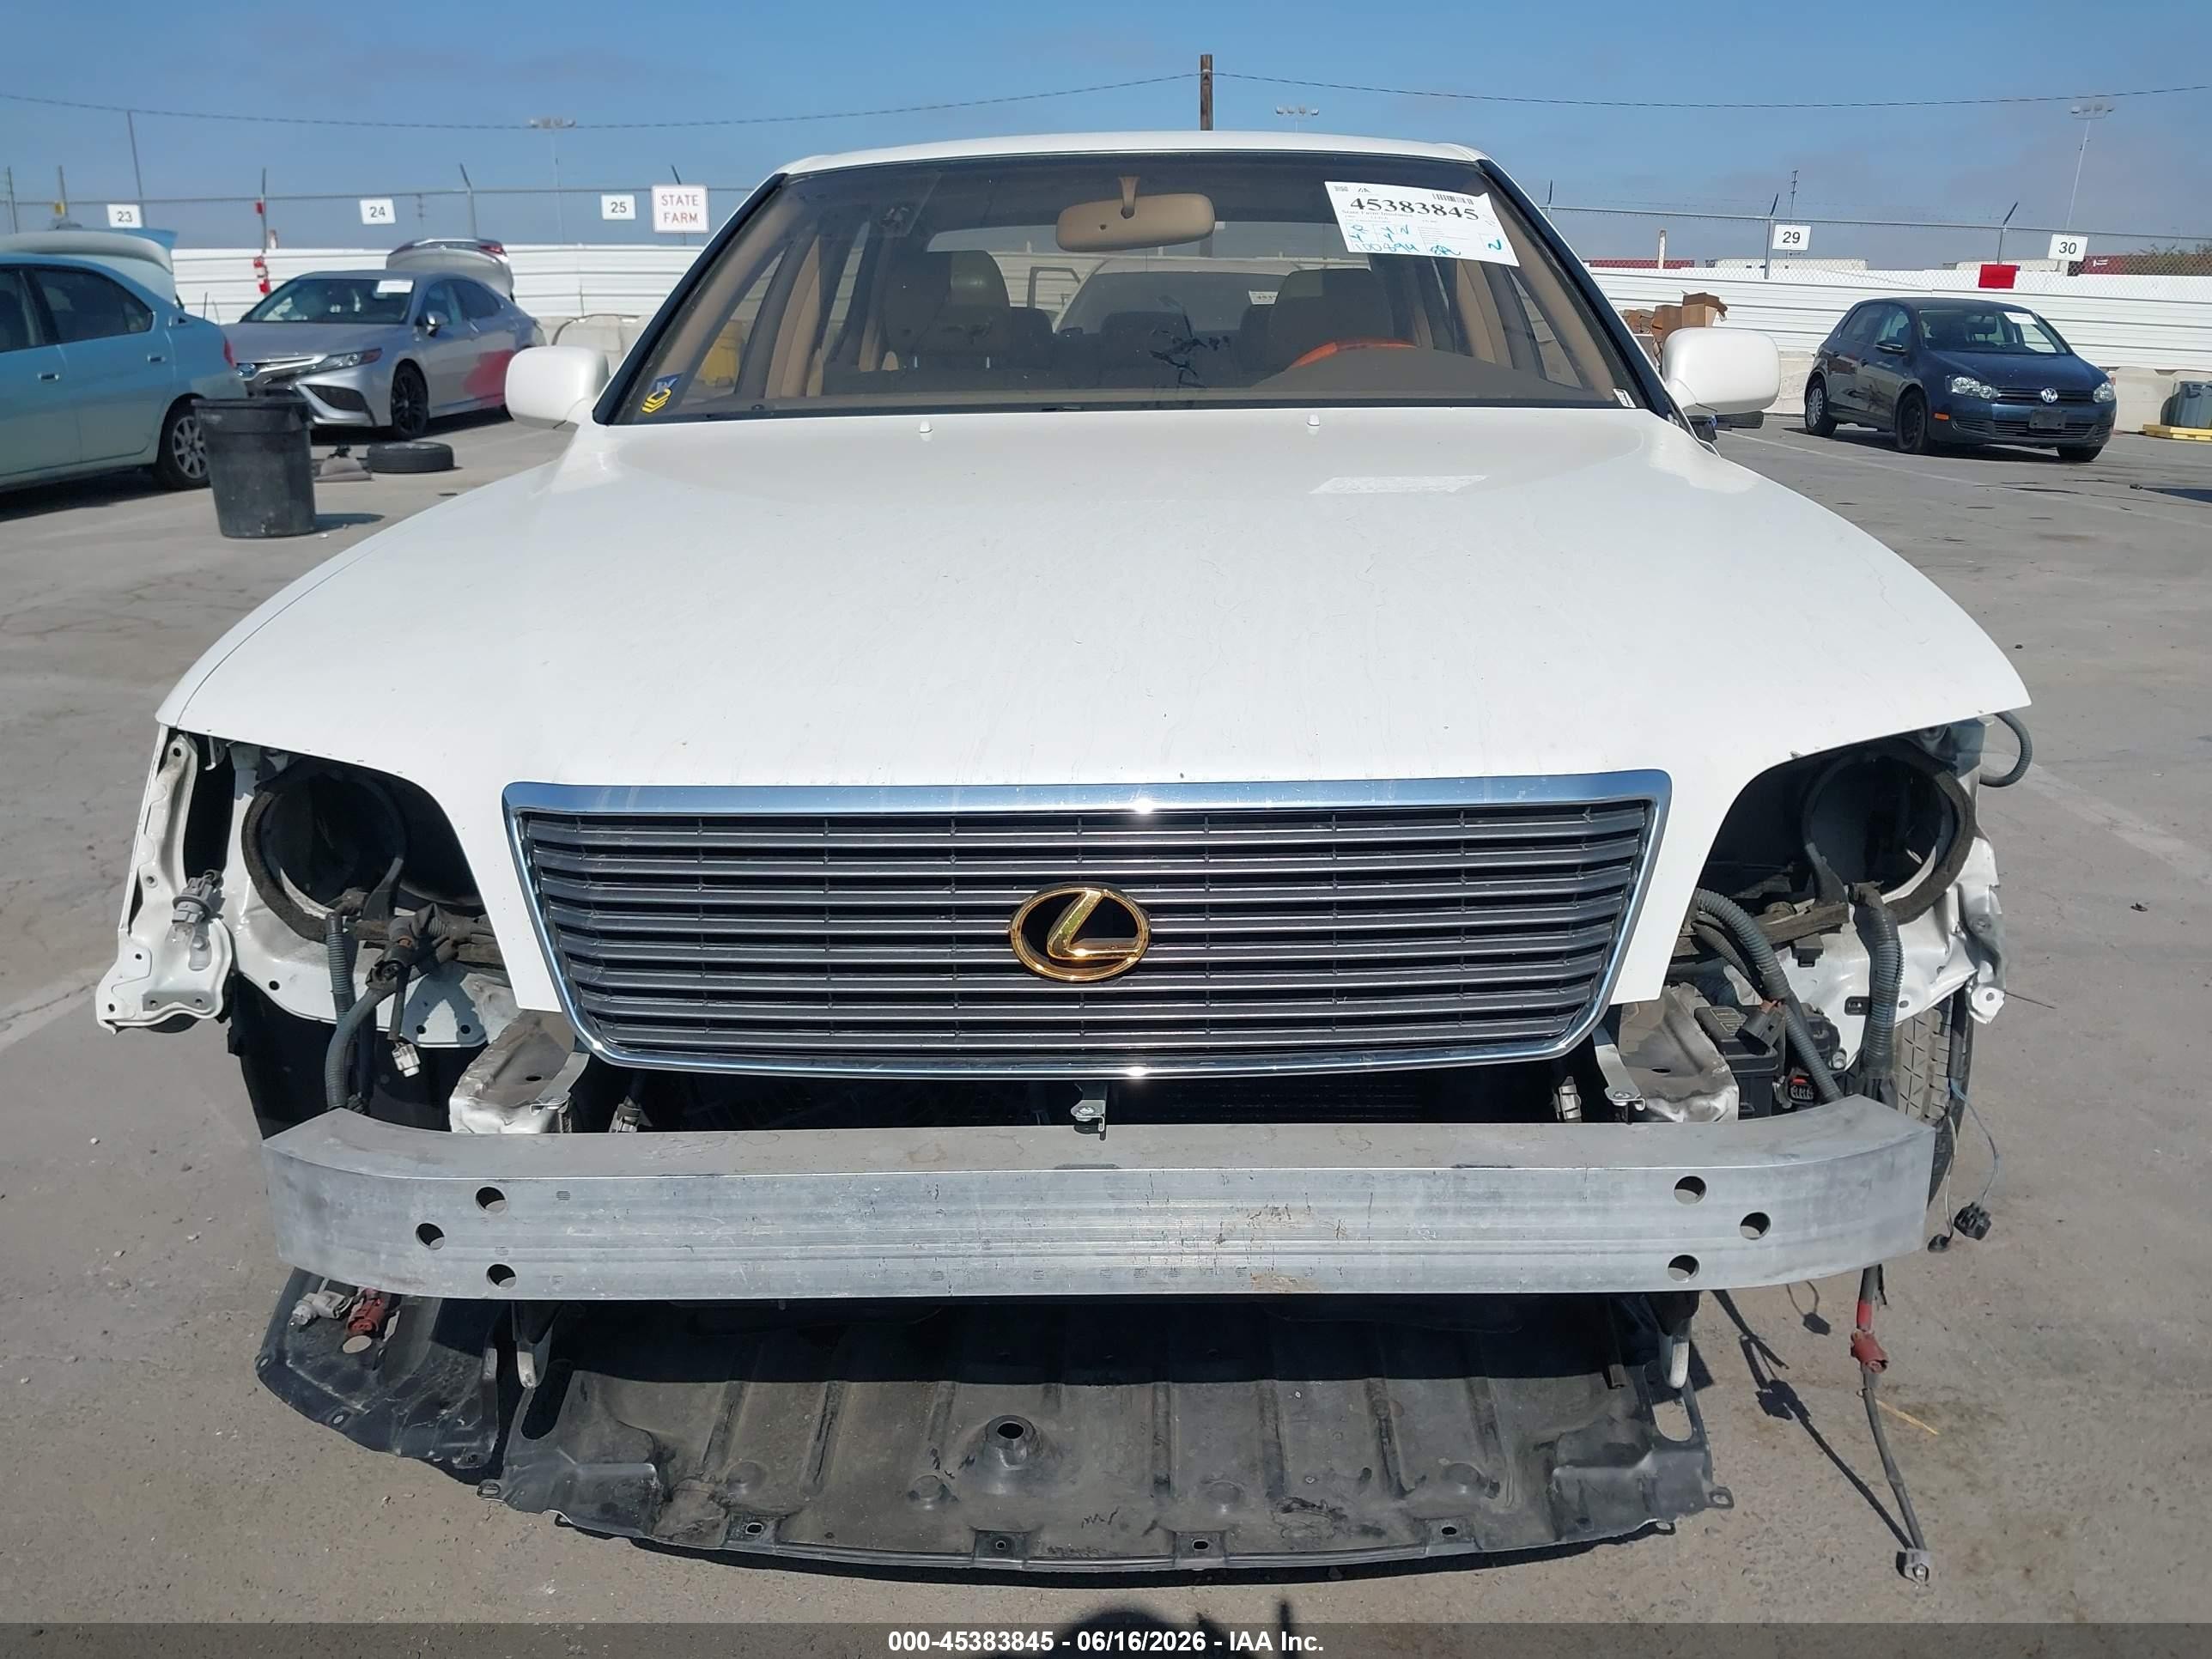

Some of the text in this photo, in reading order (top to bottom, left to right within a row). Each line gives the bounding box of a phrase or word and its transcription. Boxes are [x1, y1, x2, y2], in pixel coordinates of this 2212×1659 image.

[660, 193, 699, 207] STATE
[368, 205, 386, 218] 24
[610, 201, 628, 214] 25
[1350, 198, 1480, 221] 45383845
[116, 210, 133, 223] 23
[663, 211, 699, 224] FARM
[1781, 230, 1802, 245] 29
[2057, 241, 2078, 255] 30
